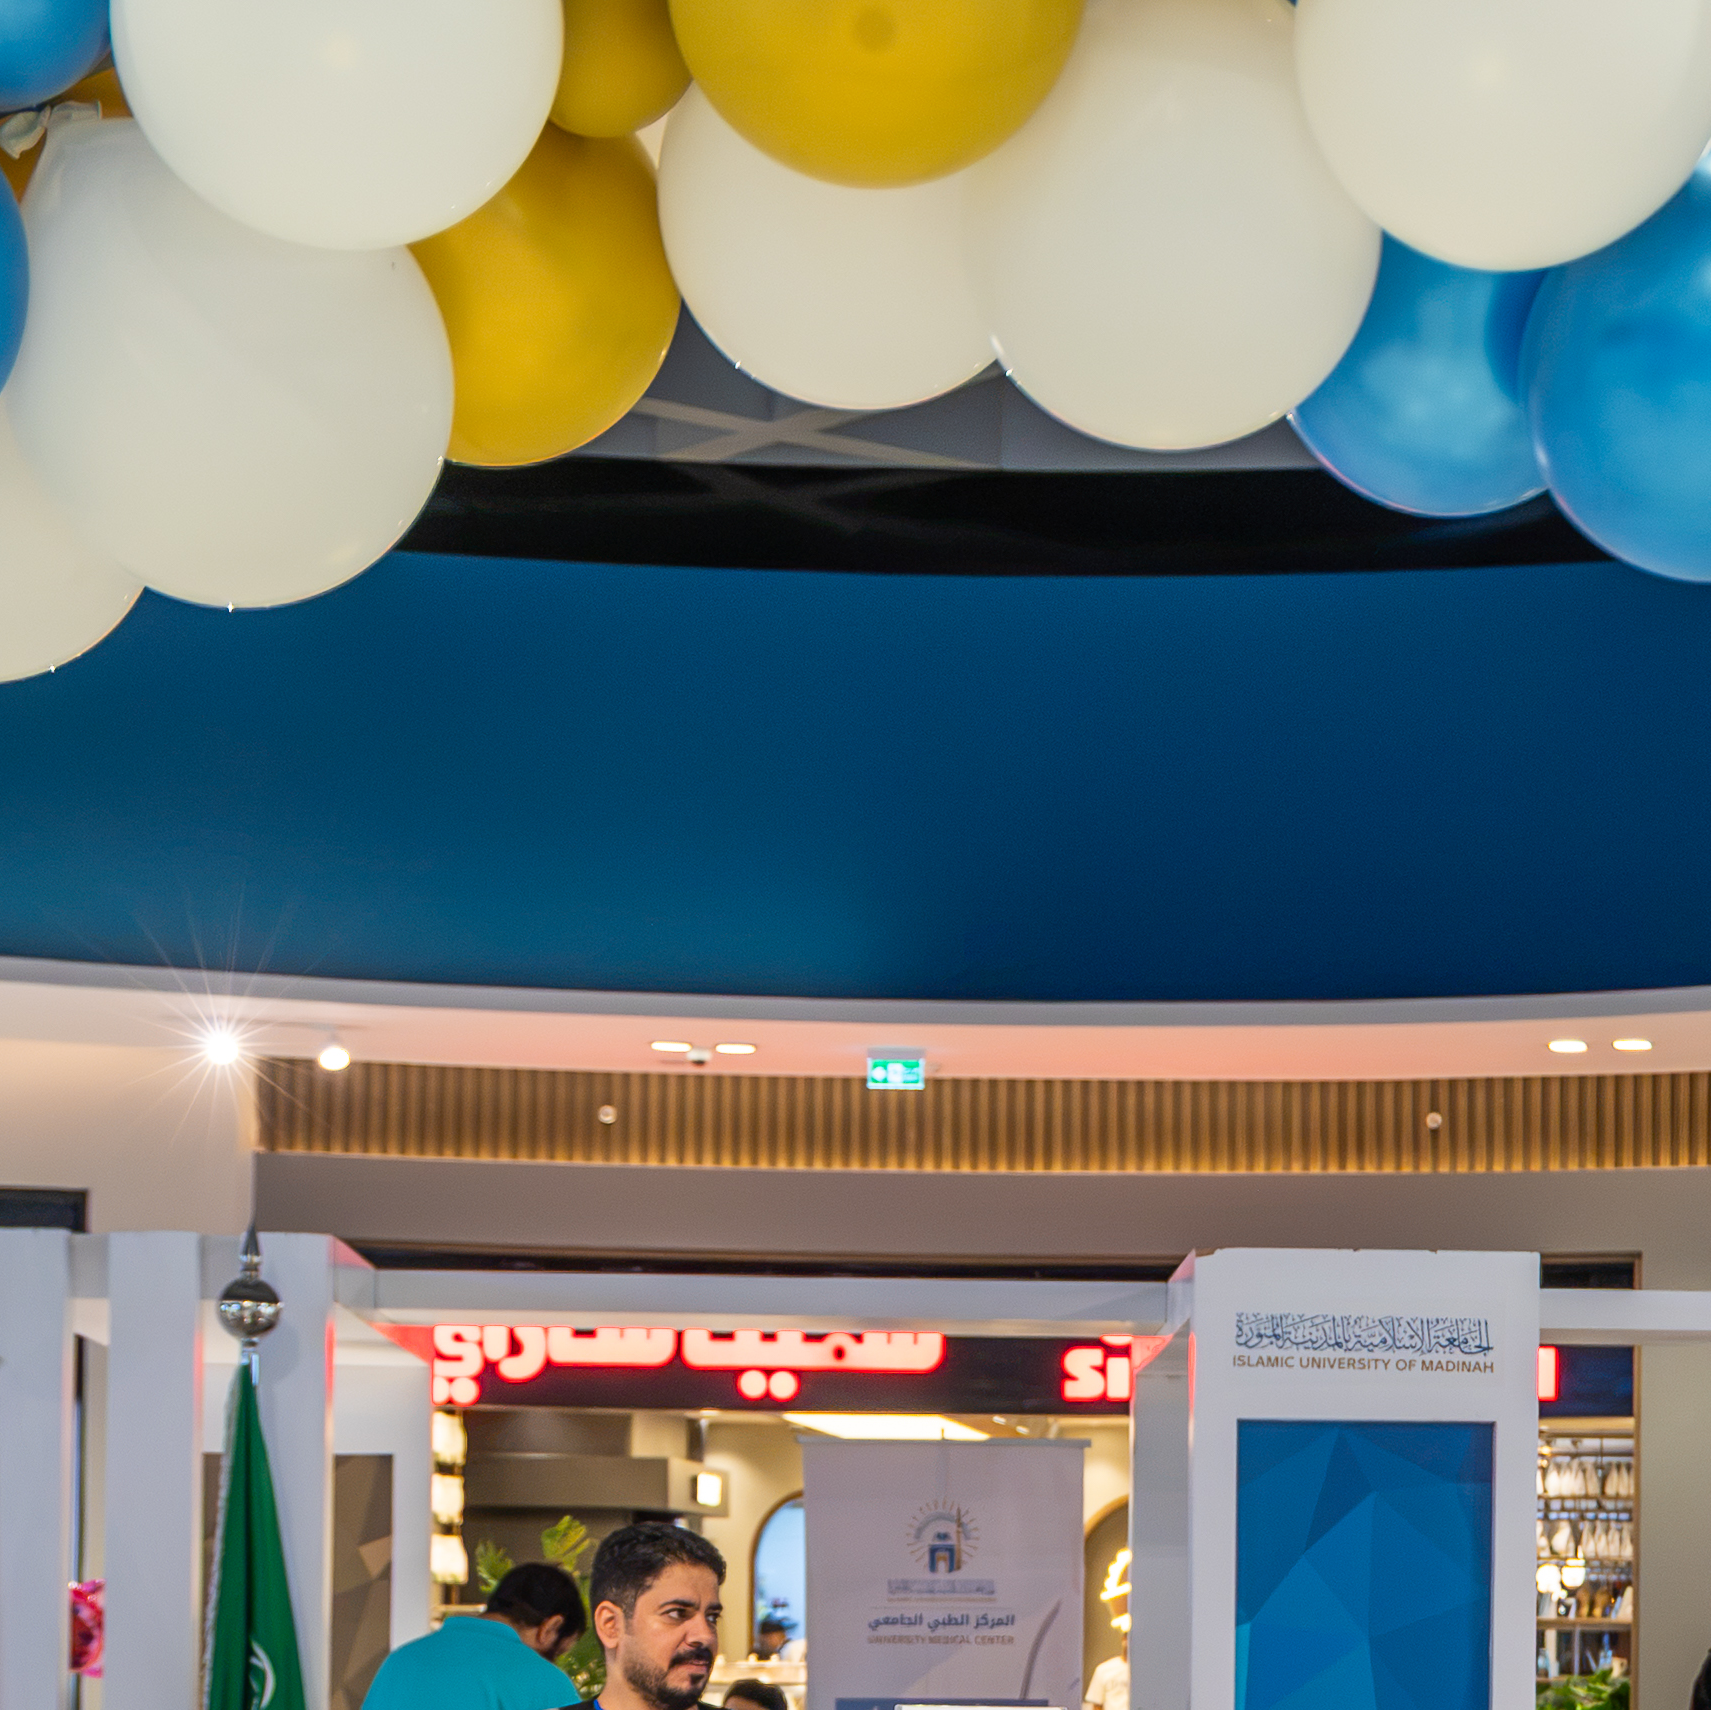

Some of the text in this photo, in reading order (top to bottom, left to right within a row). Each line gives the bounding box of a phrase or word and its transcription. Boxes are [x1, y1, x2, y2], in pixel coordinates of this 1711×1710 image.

[1232, 1354, 1495, 1373] ISLAMIC UNIVERSITY OF MADINAH
[974, 1634, 1015, 1645] CENTER
